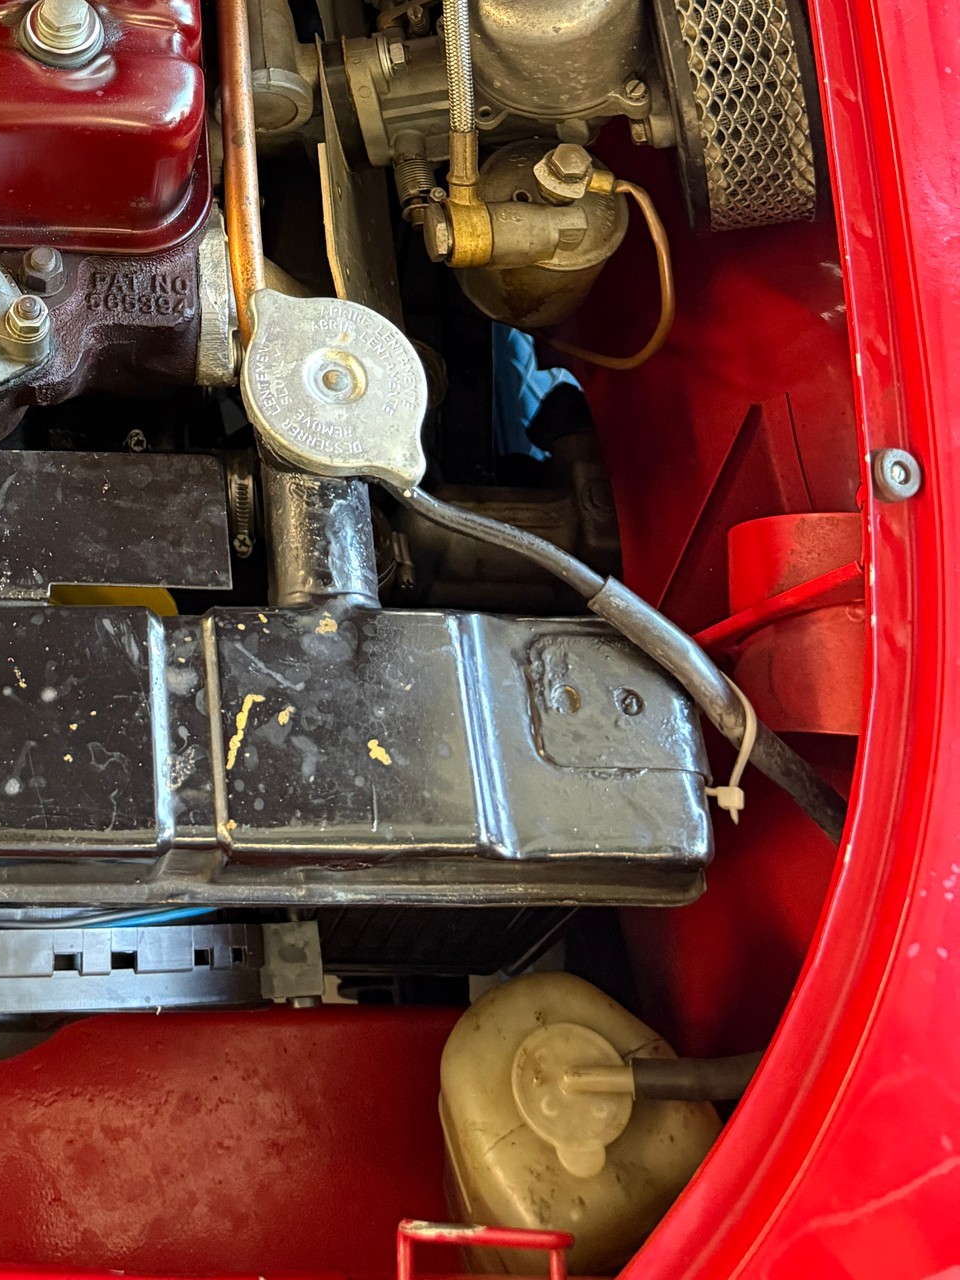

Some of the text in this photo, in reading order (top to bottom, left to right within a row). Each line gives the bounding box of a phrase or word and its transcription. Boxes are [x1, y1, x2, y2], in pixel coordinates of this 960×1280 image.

[87, 271, 189, 295] PAT NO
[256, 336, 363, 454] DESSERRER LENTEMENT
[293, 409, 354, 438] REMOVE
